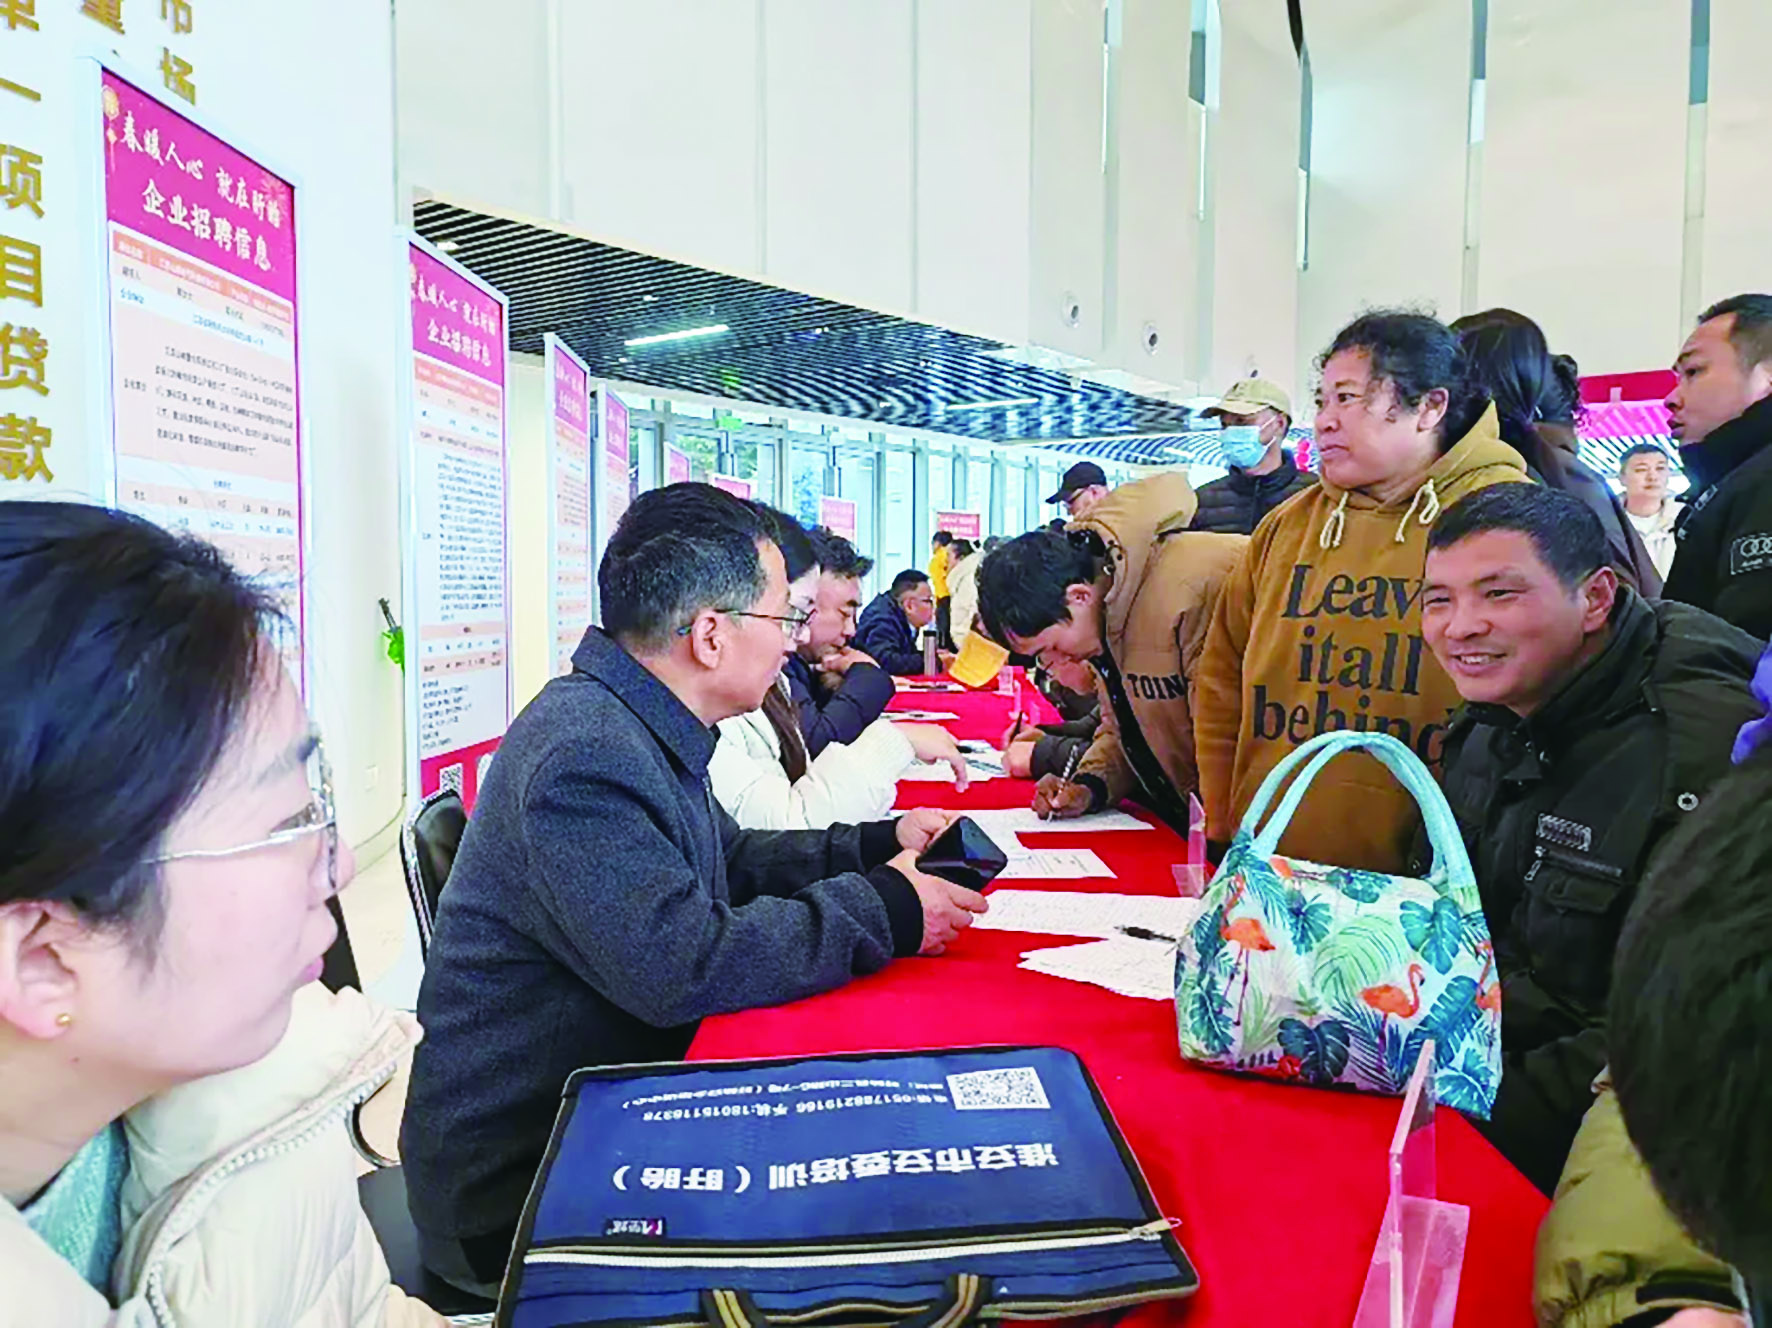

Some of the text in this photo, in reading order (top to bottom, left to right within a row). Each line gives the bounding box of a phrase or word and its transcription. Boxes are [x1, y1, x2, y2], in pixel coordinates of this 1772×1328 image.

[120, 110, 204, 181] 春暖人心
[141, 177, 273, 273] 企业招聘信息
[1281, 564, 1424, 620] Leav
